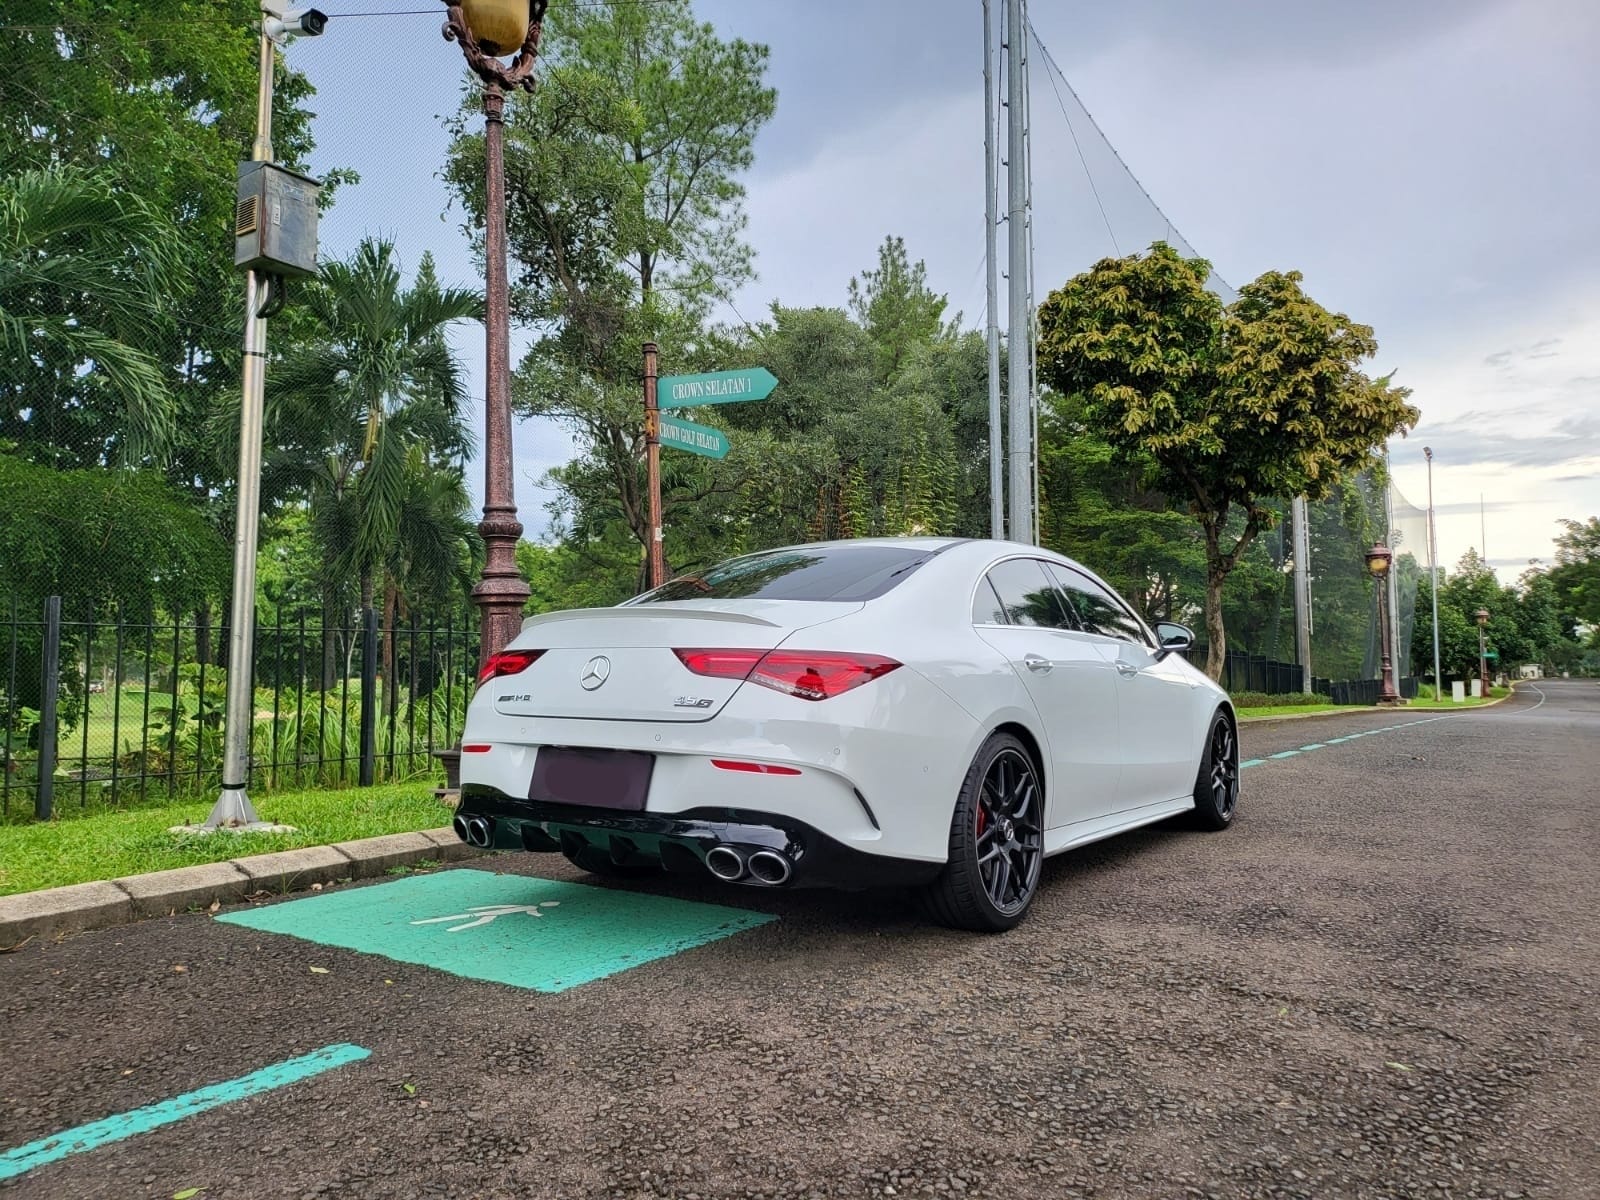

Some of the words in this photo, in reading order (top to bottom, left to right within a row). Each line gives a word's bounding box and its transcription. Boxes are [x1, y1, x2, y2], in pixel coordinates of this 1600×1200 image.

[672, 382, 703, 399] CROWN
[706, 378, 745, 395] SELATAN
[747, 378, 752, 392] 1
[659, 422, 680, 441] CROWN
[681, 428, 695, 445] GOLF
[696, 432, 720, 451] SELATAN
